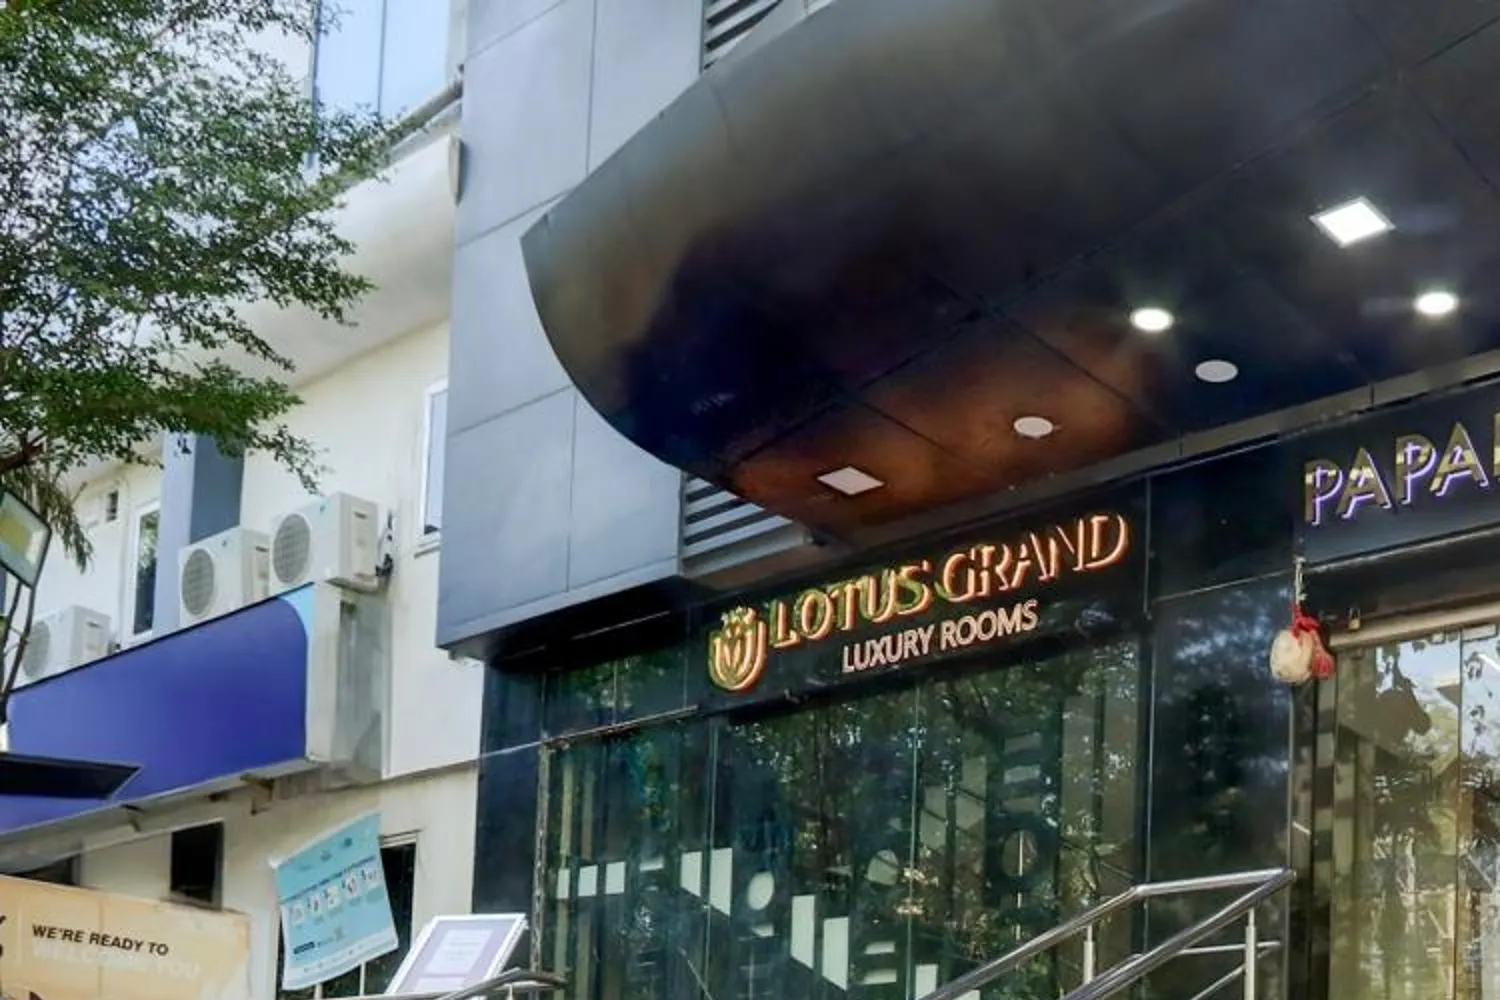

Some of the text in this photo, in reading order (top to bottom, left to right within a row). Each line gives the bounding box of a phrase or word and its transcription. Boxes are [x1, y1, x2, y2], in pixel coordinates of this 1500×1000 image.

[768, 513, 1130, 649] LOTUS GRAND
[841, 599, 1039, 674] LUXURY ROOMS
[31, 924, 170, 957] WE'RE READY TO
